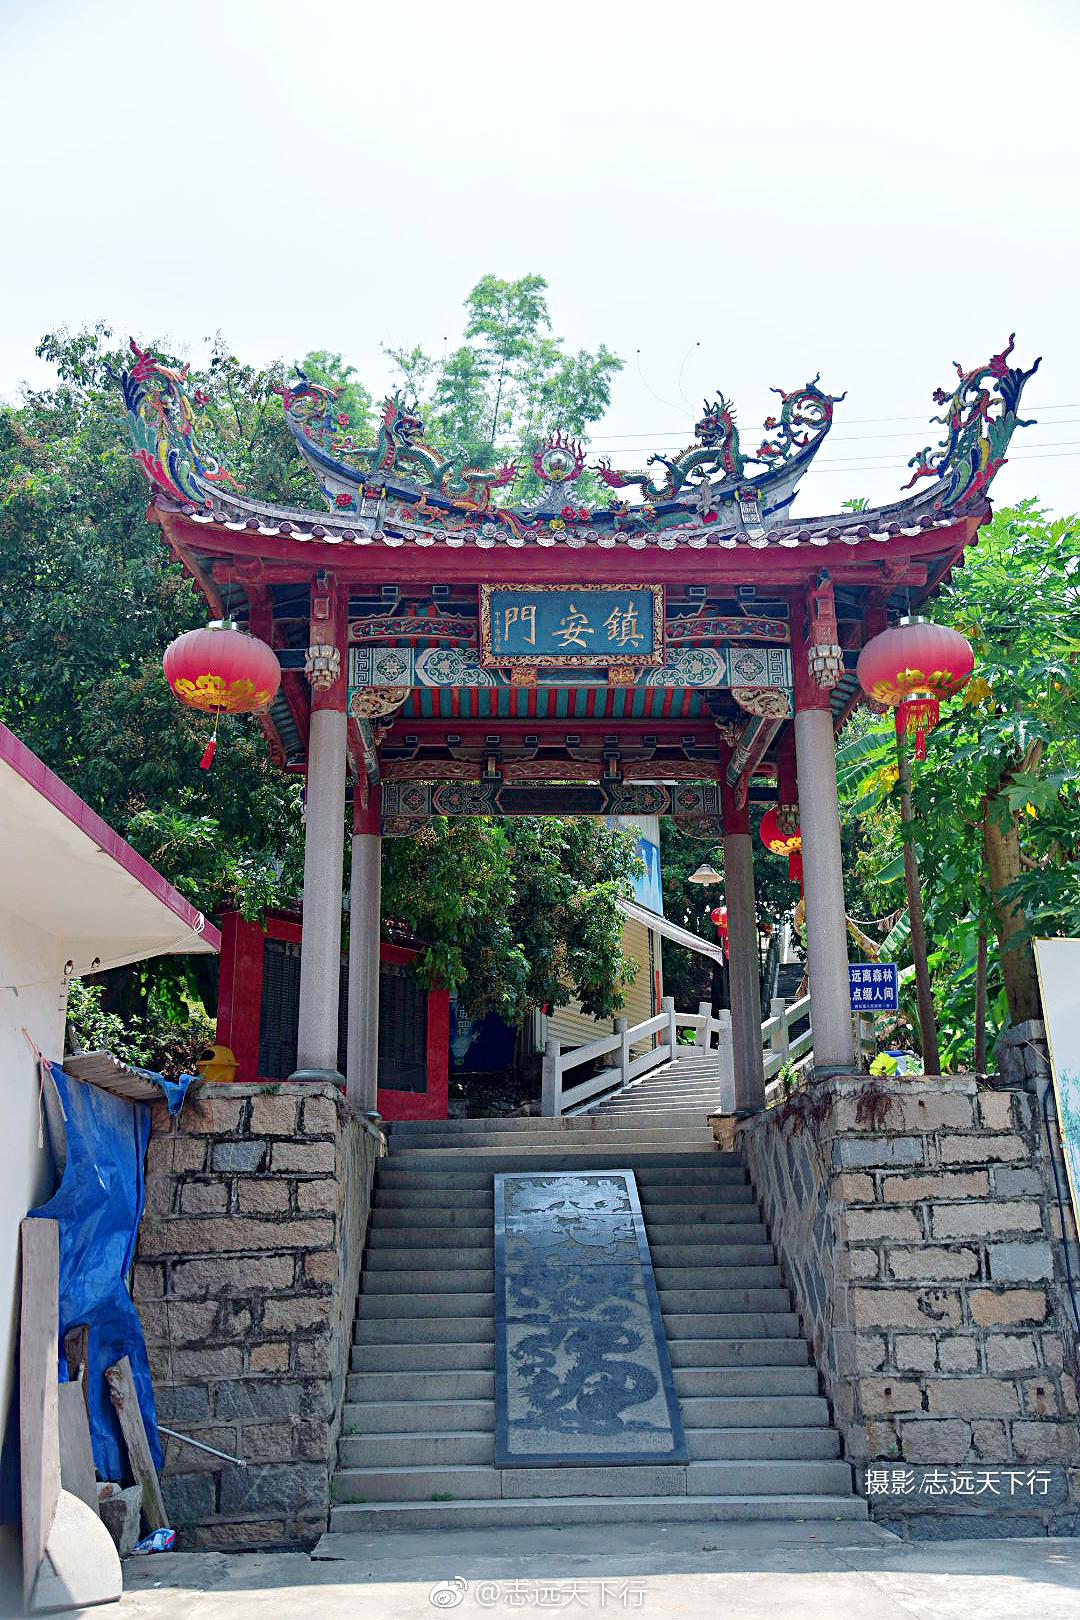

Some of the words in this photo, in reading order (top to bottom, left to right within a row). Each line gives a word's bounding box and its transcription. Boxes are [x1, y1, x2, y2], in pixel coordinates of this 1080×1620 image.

[848, 968, 893, 983] 远离森林
[849, 987, 894, 1001] 点缀人间
